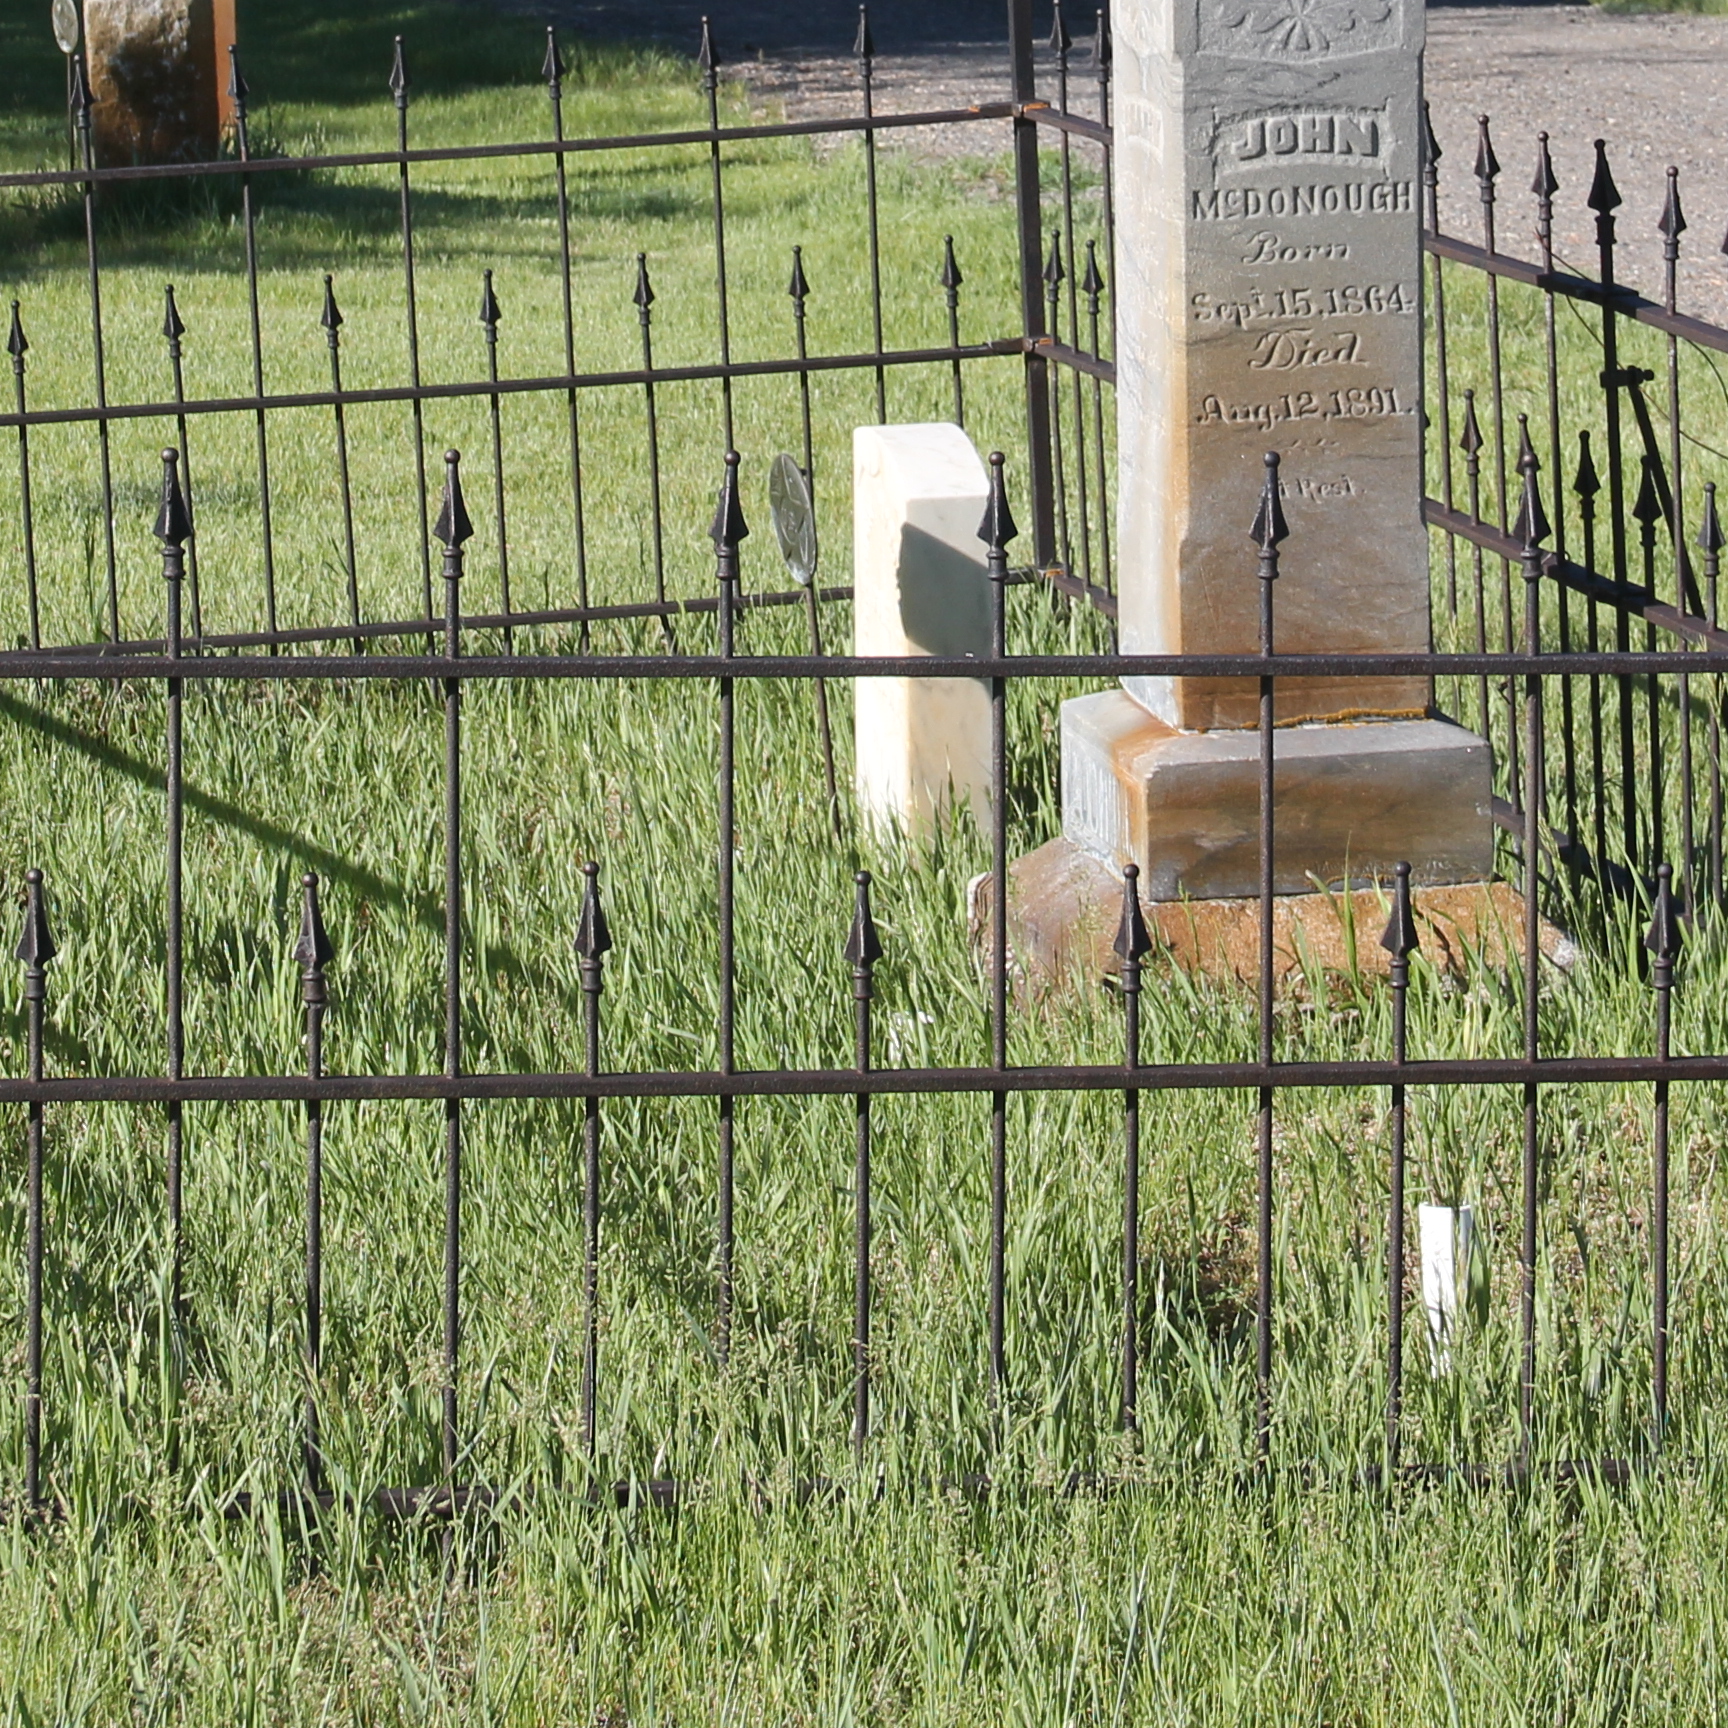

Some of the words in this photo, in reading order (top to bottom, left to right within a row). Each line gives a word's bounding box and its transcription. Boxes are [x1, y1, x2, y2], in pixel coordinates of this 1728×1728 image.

[1230, 114, 1380, 161] JOHN
[1192, 180, 1415, 221] McDONOUGH
[1241, 230, 1351, 265] Born
[1247, 326, 1371, 372] Died
